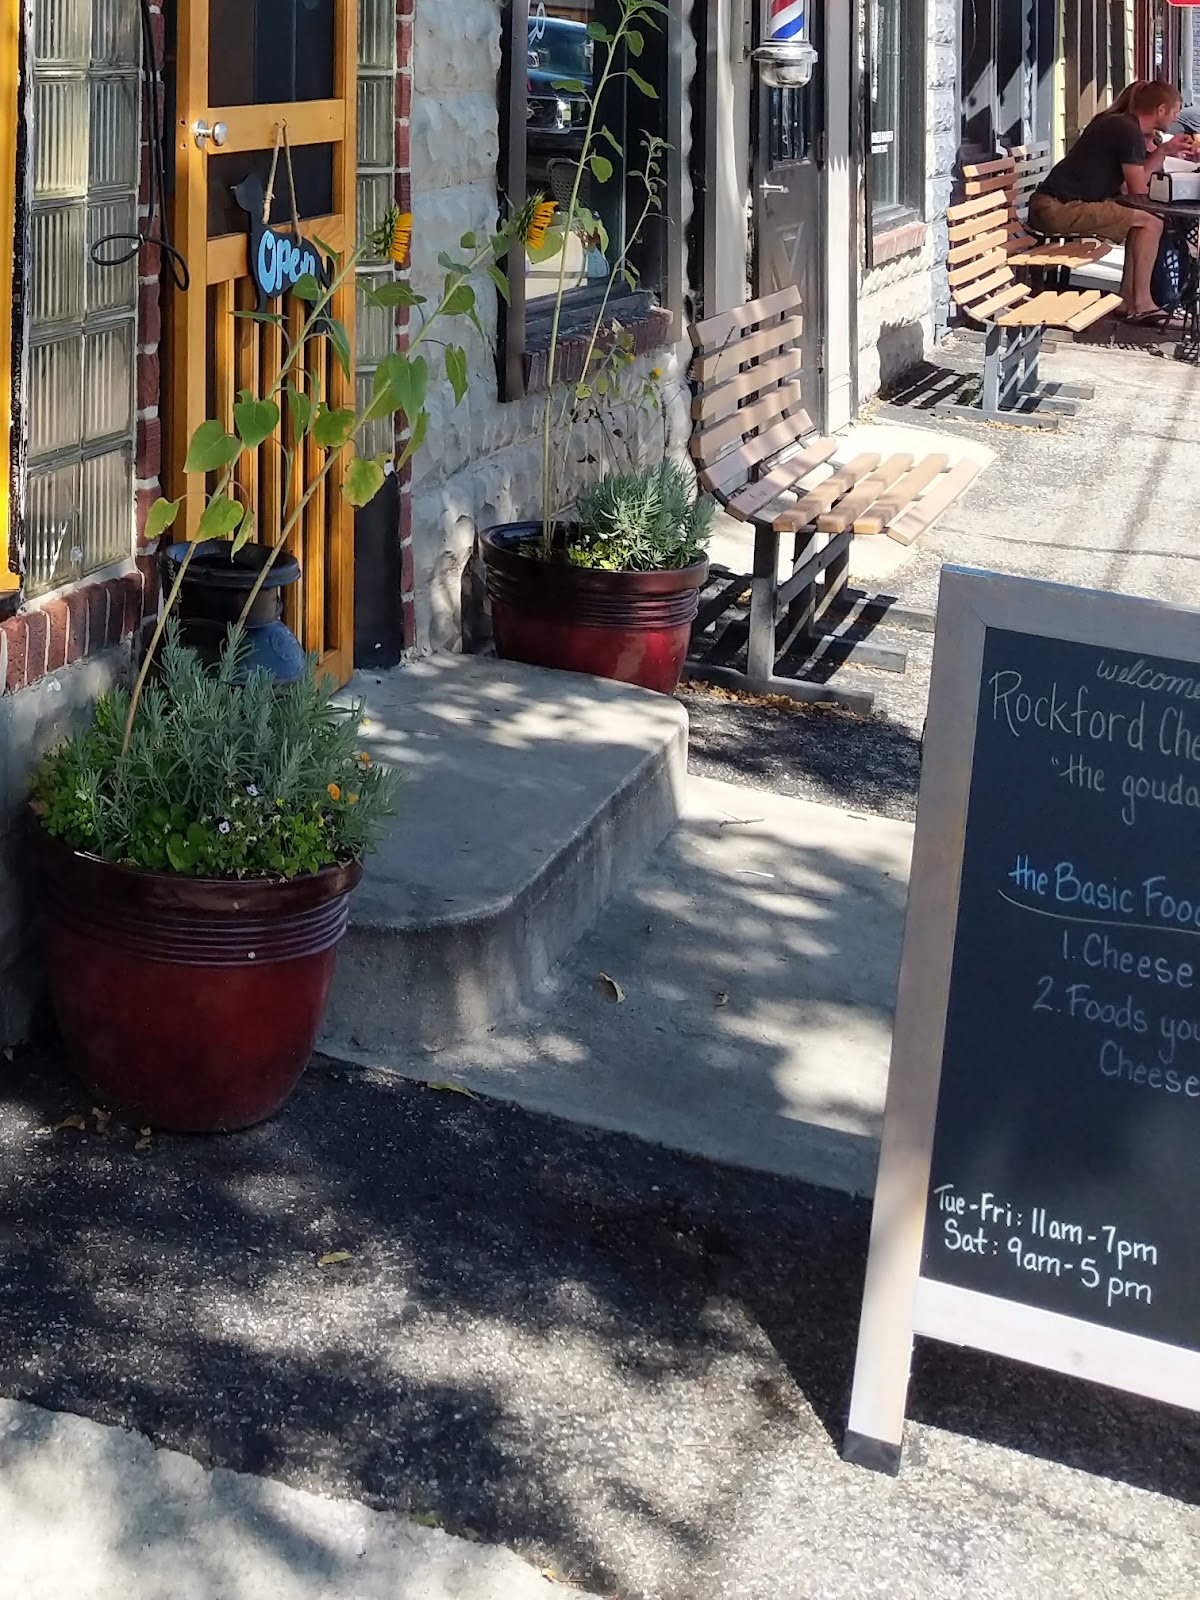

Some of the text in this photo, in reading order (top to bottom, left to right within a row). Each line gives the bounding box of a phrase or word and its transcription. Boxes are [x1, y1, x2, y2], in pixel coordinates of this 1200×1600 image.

[989, 670, 1145, 751] Rockford
[1122, 774, 1200, 825] gouda
[1007, 854, 1048, 896] the
[1054, 862, 1134, 913] Basic
[1083, 933, 1194, 988] Cheese
[1033, 975, 1062, 1013] 2.
[1066, 983, 1148, 1032] Foods
[1100, 1040, 1200, 1097] Cheese
[934, 1184, 1022, 1227] Tue-Fri:
[944, 1218, 999, 1255] Sat:
